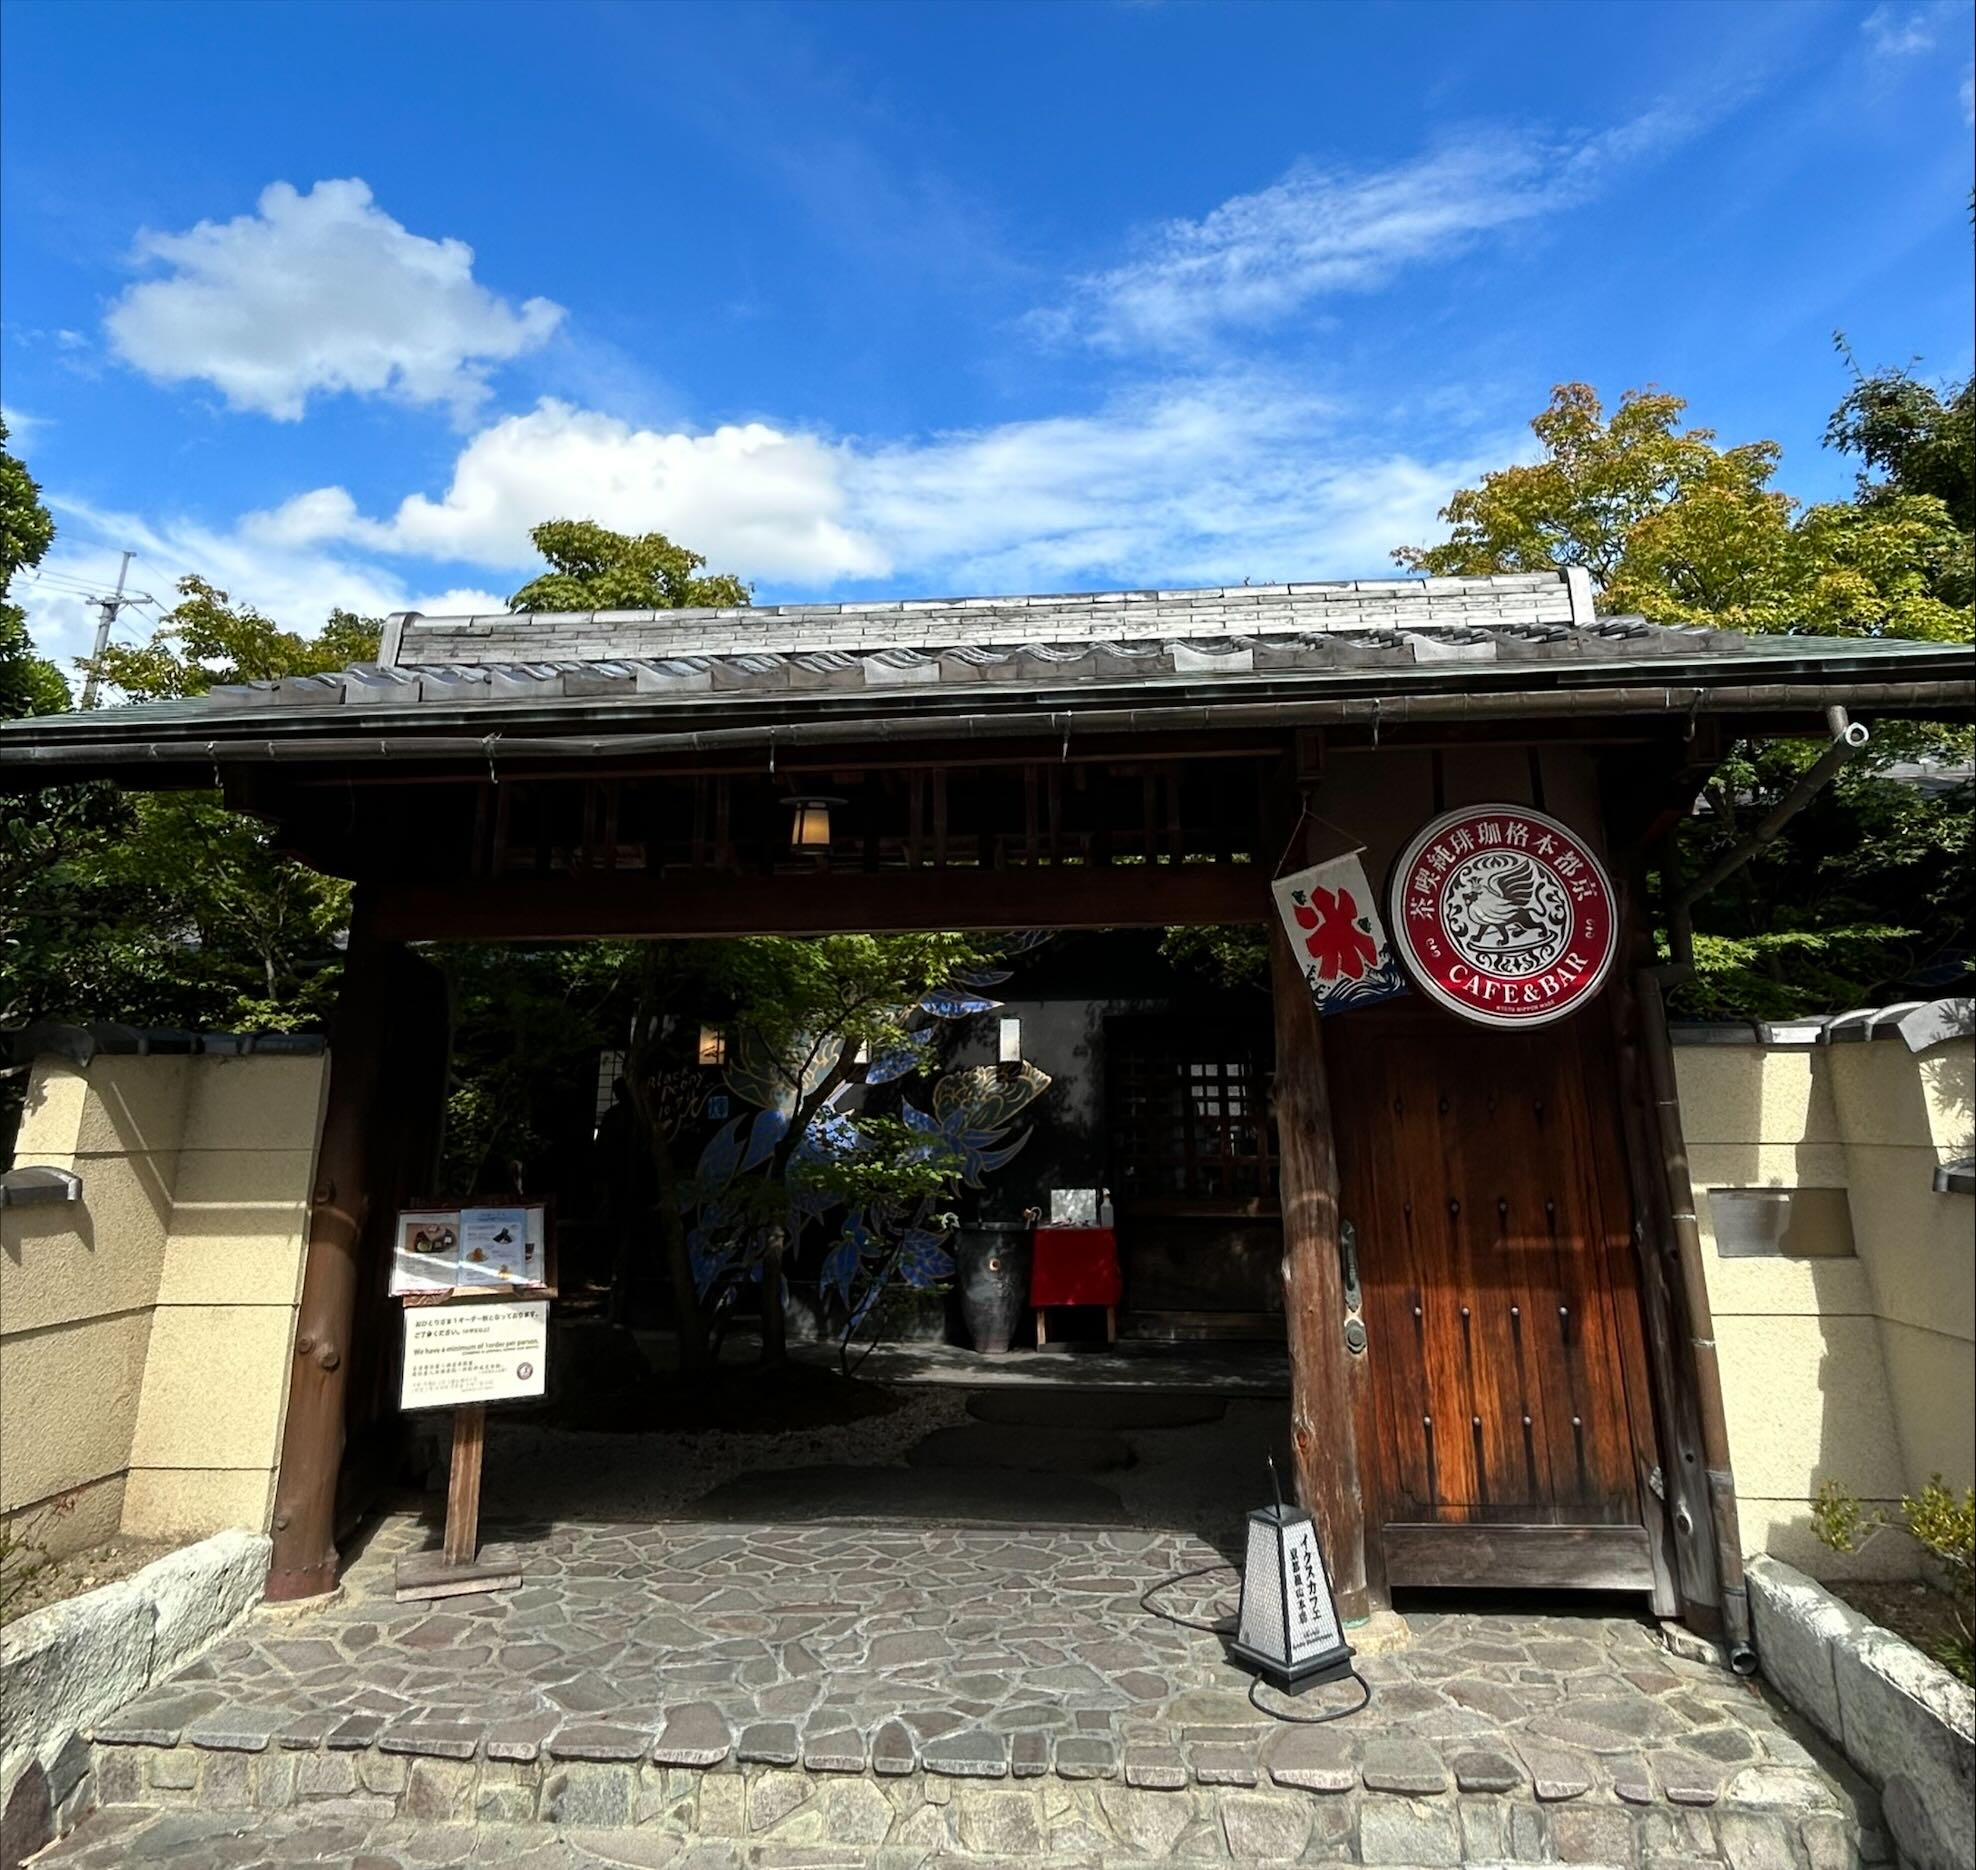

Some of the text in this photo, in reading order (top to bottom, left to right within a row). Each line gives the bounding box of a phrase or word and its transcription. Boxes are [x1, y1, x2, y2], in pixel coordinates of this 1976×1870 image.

[1292, 885, 1379, 981] 氷
[1449, 952, 1589, 1004] CAFE&BAR
[414, 1348, 424, 1356] We
[425, 1347, 441, 1355] have
[447, 1344, 477, 1353] minimum
[506, 1341, 517, 1349] per
[1300, 1533, 1322, 1620] イクスカフェ
